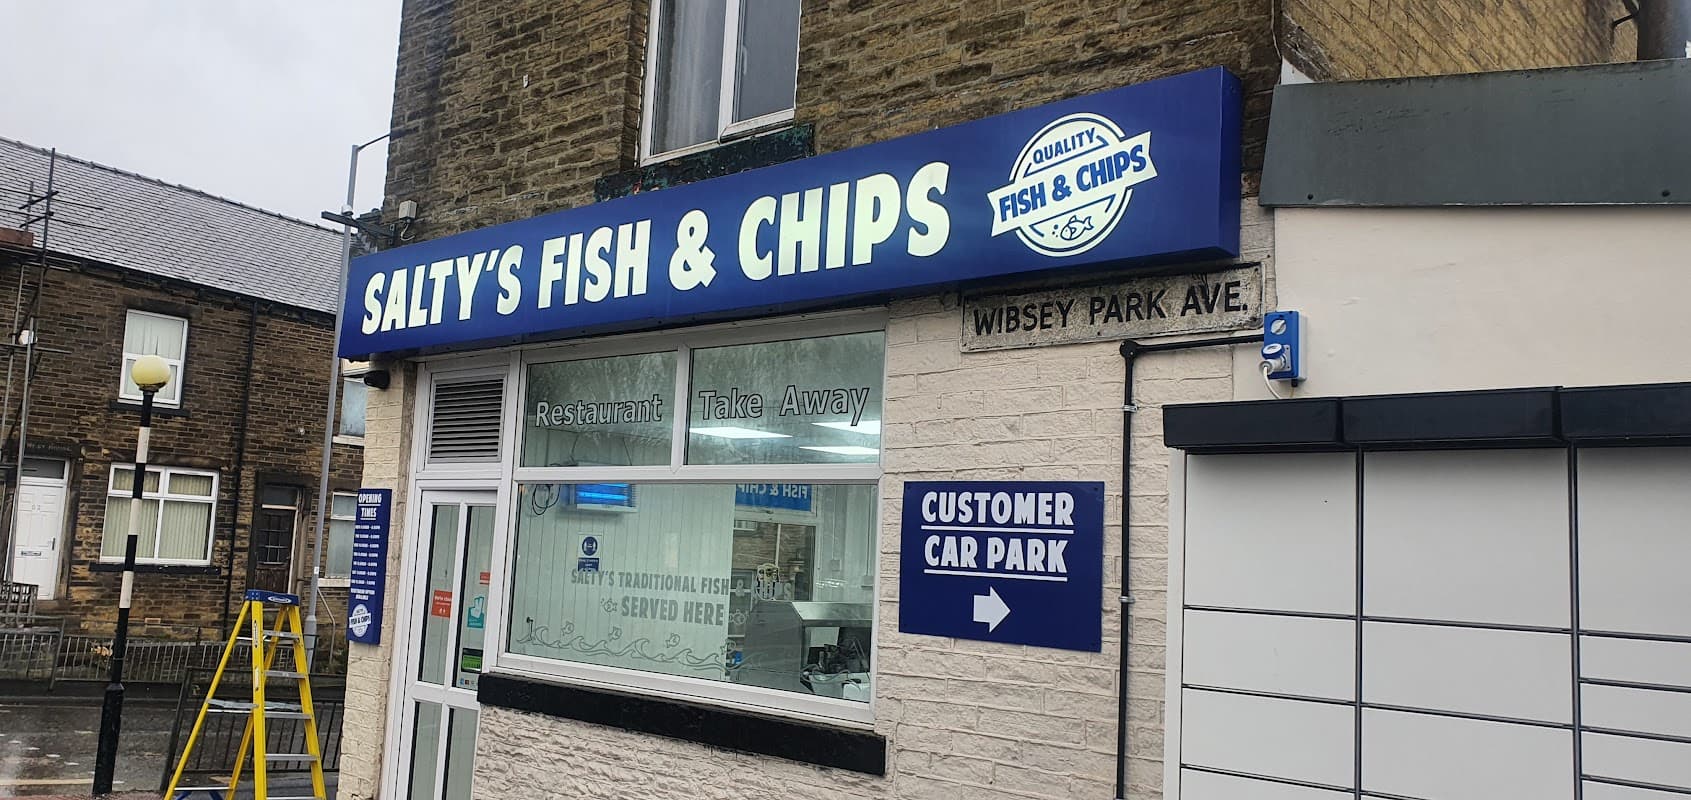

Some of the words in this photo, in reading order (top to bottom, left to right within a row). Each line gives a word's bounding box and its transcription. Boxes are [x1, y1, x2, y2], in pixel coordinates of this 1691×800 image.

[1033, 128, 1096, 164] QUALITY
[999, 183, 1047, 222] FISH
[1052, 174, 1072, 201] &
[1076, 144, 1147, 192] CHIPS
[361, 245, 524, 335] SALTY'S
[538, 219, 652, 310] FISH
[668, 209, 717, 291] &
[738, 161, 950, 281] CHIPS
[973, 299, 1076, 337] WIBSEY
[1089, 290, 1167, 325] PARK
[1181, 281, 1249, 316] AVE.
[535, 394, 663, 427] Restaurant
[699, 388, 763, 420] Take
[779, 385, 871, 426] Away
[358, 494, 382, 503] OPENING
[361, 508, 377, 517] TIMES
[921, 491, 1075, 526] CUSTOMER
[924, 535, 978, 568] CAR
[986, 537, 1068, 573] PARK
[618, 571, 697, 593] TRADITIONAL
[700, 577, 730, 596] FISH
[621, 596, 679, 622] SERVED
[683, 601, 724, 626] HERE
